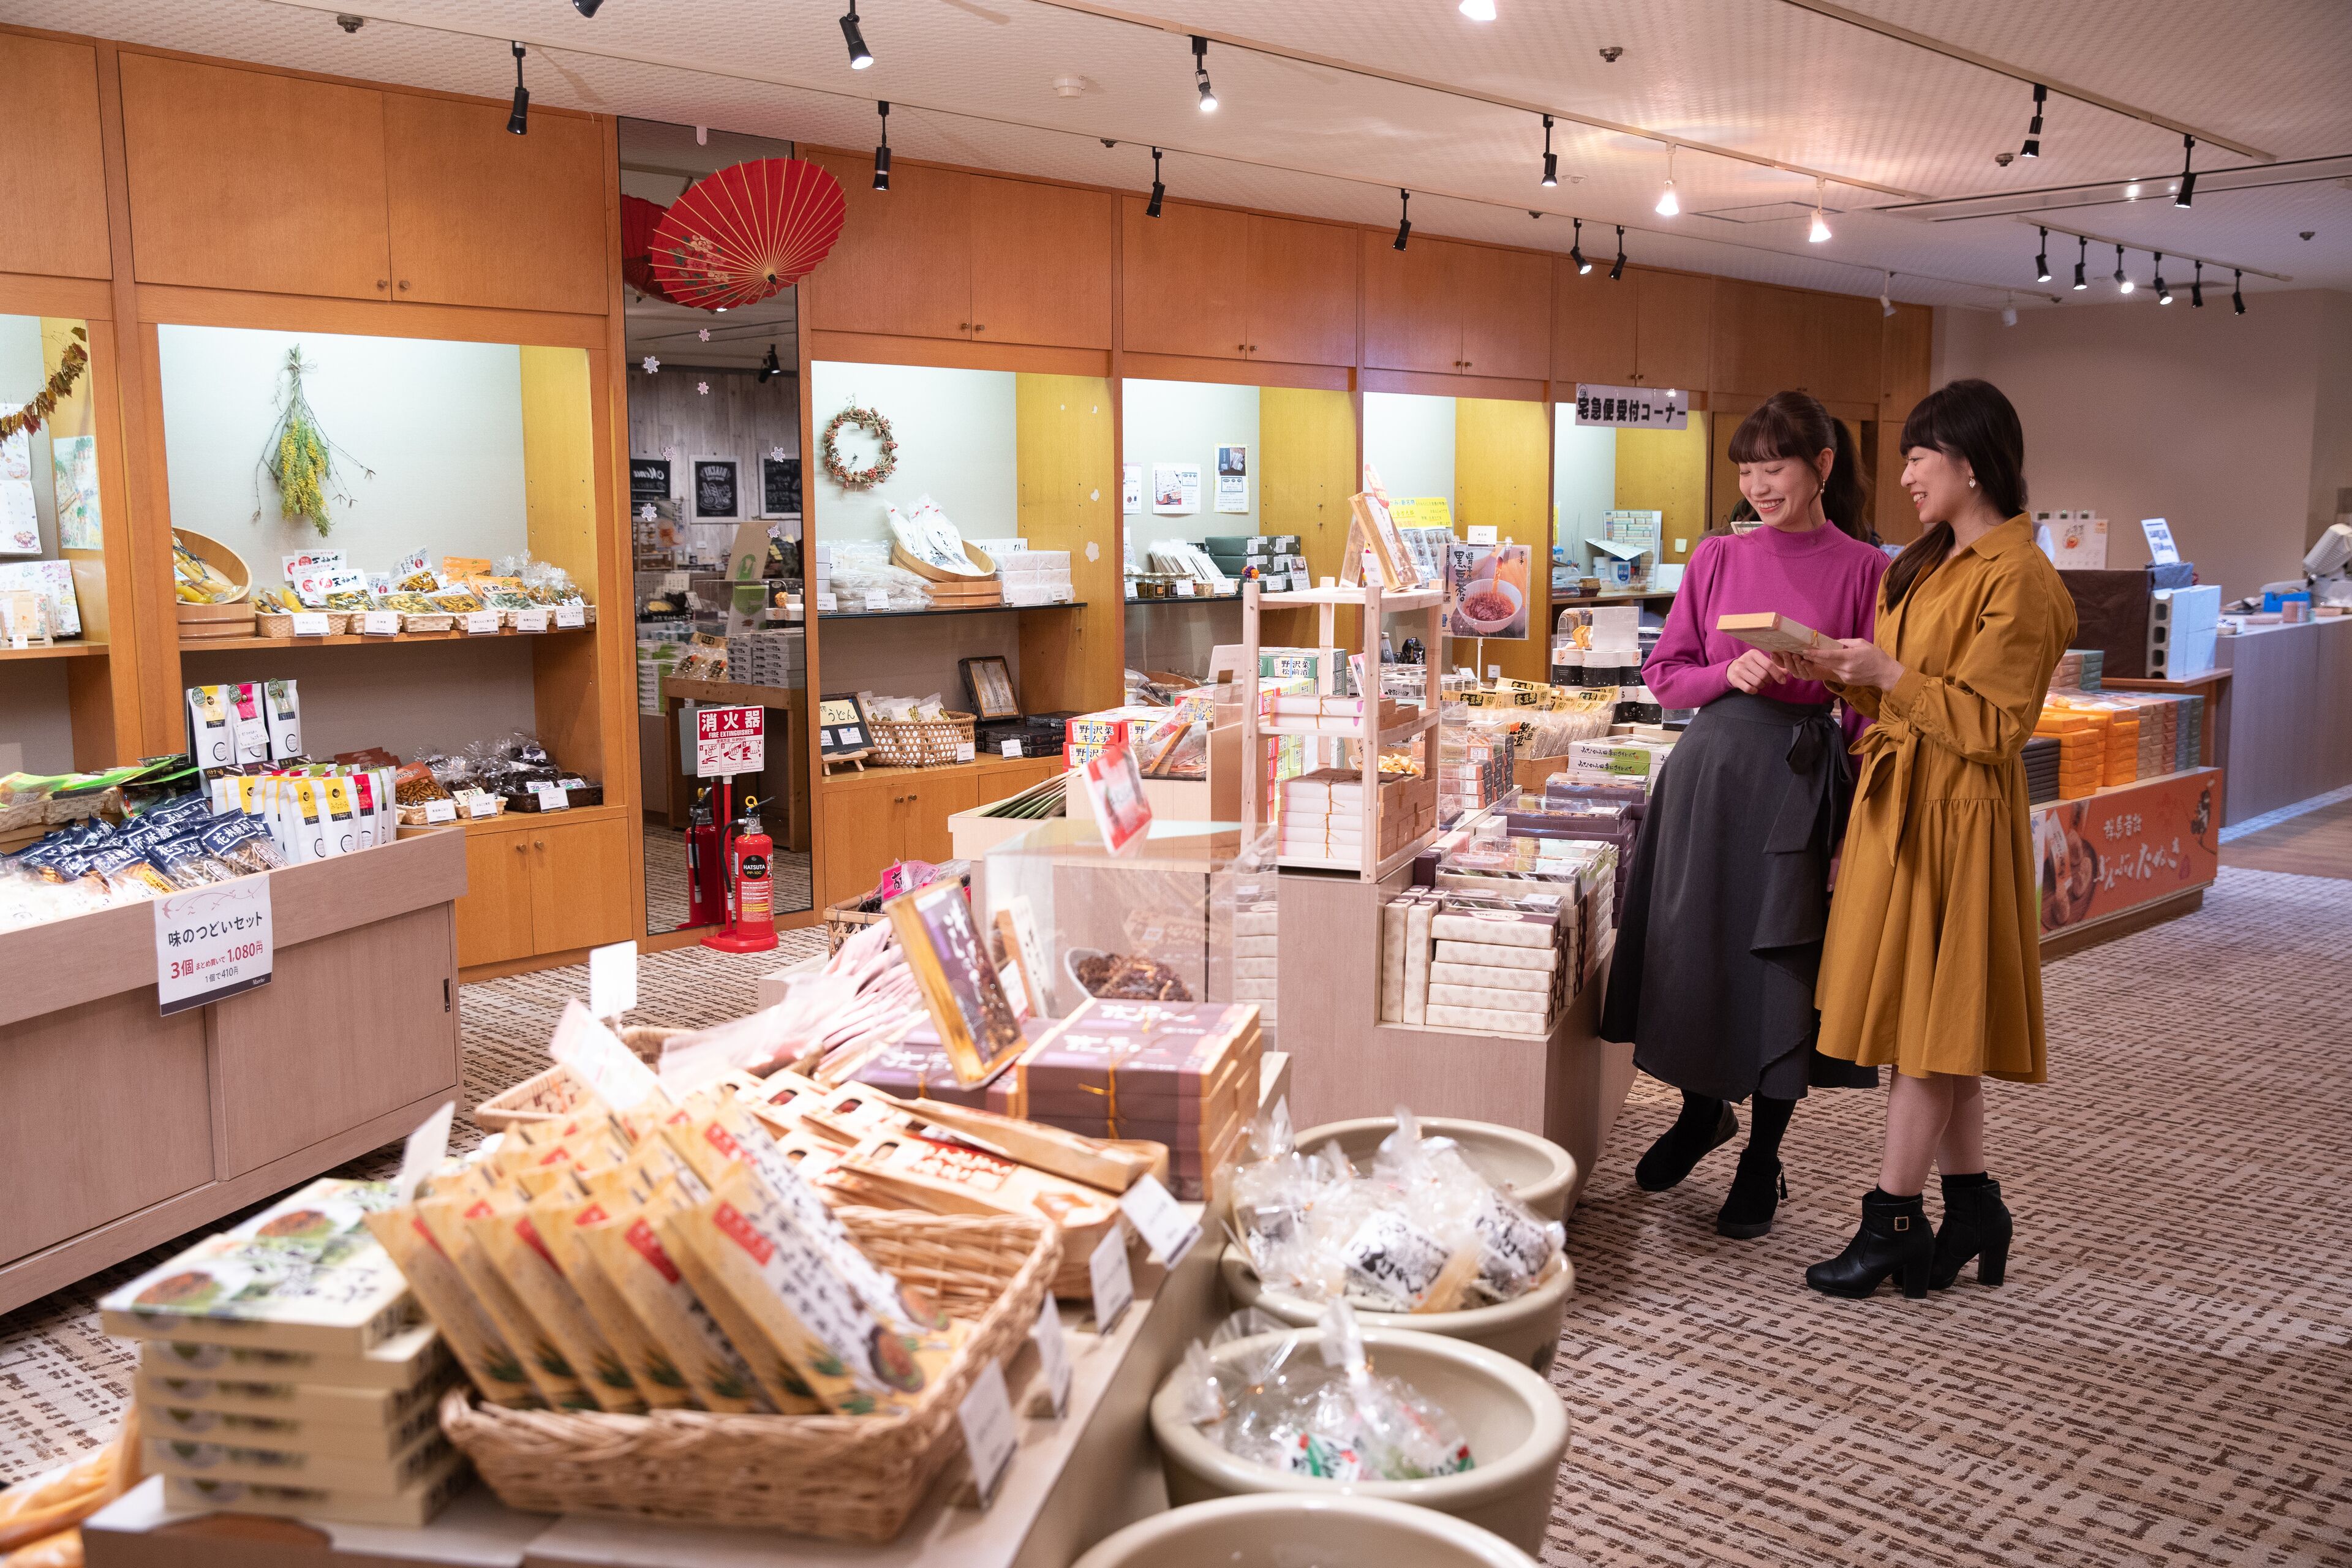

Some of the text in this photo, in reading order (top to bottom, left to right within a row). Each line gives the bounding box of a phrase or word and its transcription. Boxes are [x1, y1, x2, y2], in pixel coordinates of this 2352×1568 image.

[1577, 397, 1686, 424] 宅急便受付コーナー
[1281, 660, 1310, 669] 野沢菜
[701, 710, 761, 732] 消火器
[828, 709, 855, 722] うどん
[720, 729, 754, 737] EXTINGUISHER
[1079, 725, 1114, 735] 野沢菜
[1081, 734, 1110, 743] キムチ
[168, 911, 263, 948] 味のつどいセット
[171, 943, 263, 979] 3個 まとめ買いで 1,080円
